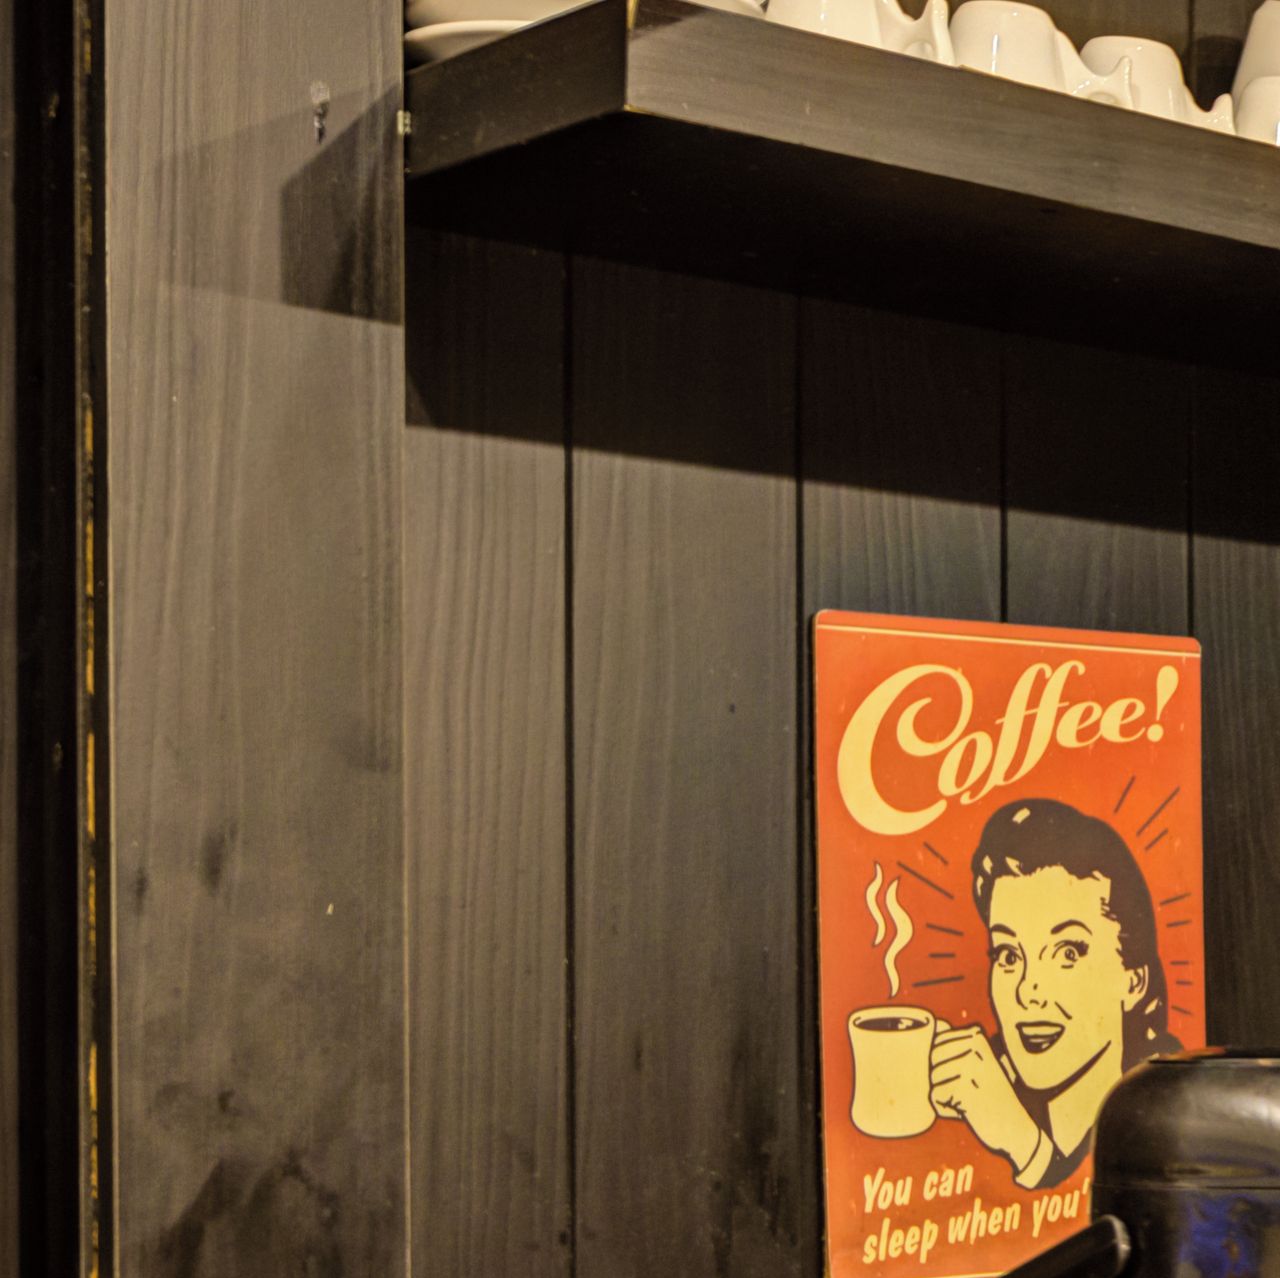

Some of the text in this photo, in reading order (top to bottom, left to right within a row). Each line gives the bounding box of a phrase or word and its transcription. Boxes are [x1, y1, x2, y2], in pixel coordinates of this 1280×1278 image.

[837, 660, 1179, 836] Coffee!
[862, 1176, 1091, 1265] sleep when you'
[863, 1164, 974, 1213] You can
